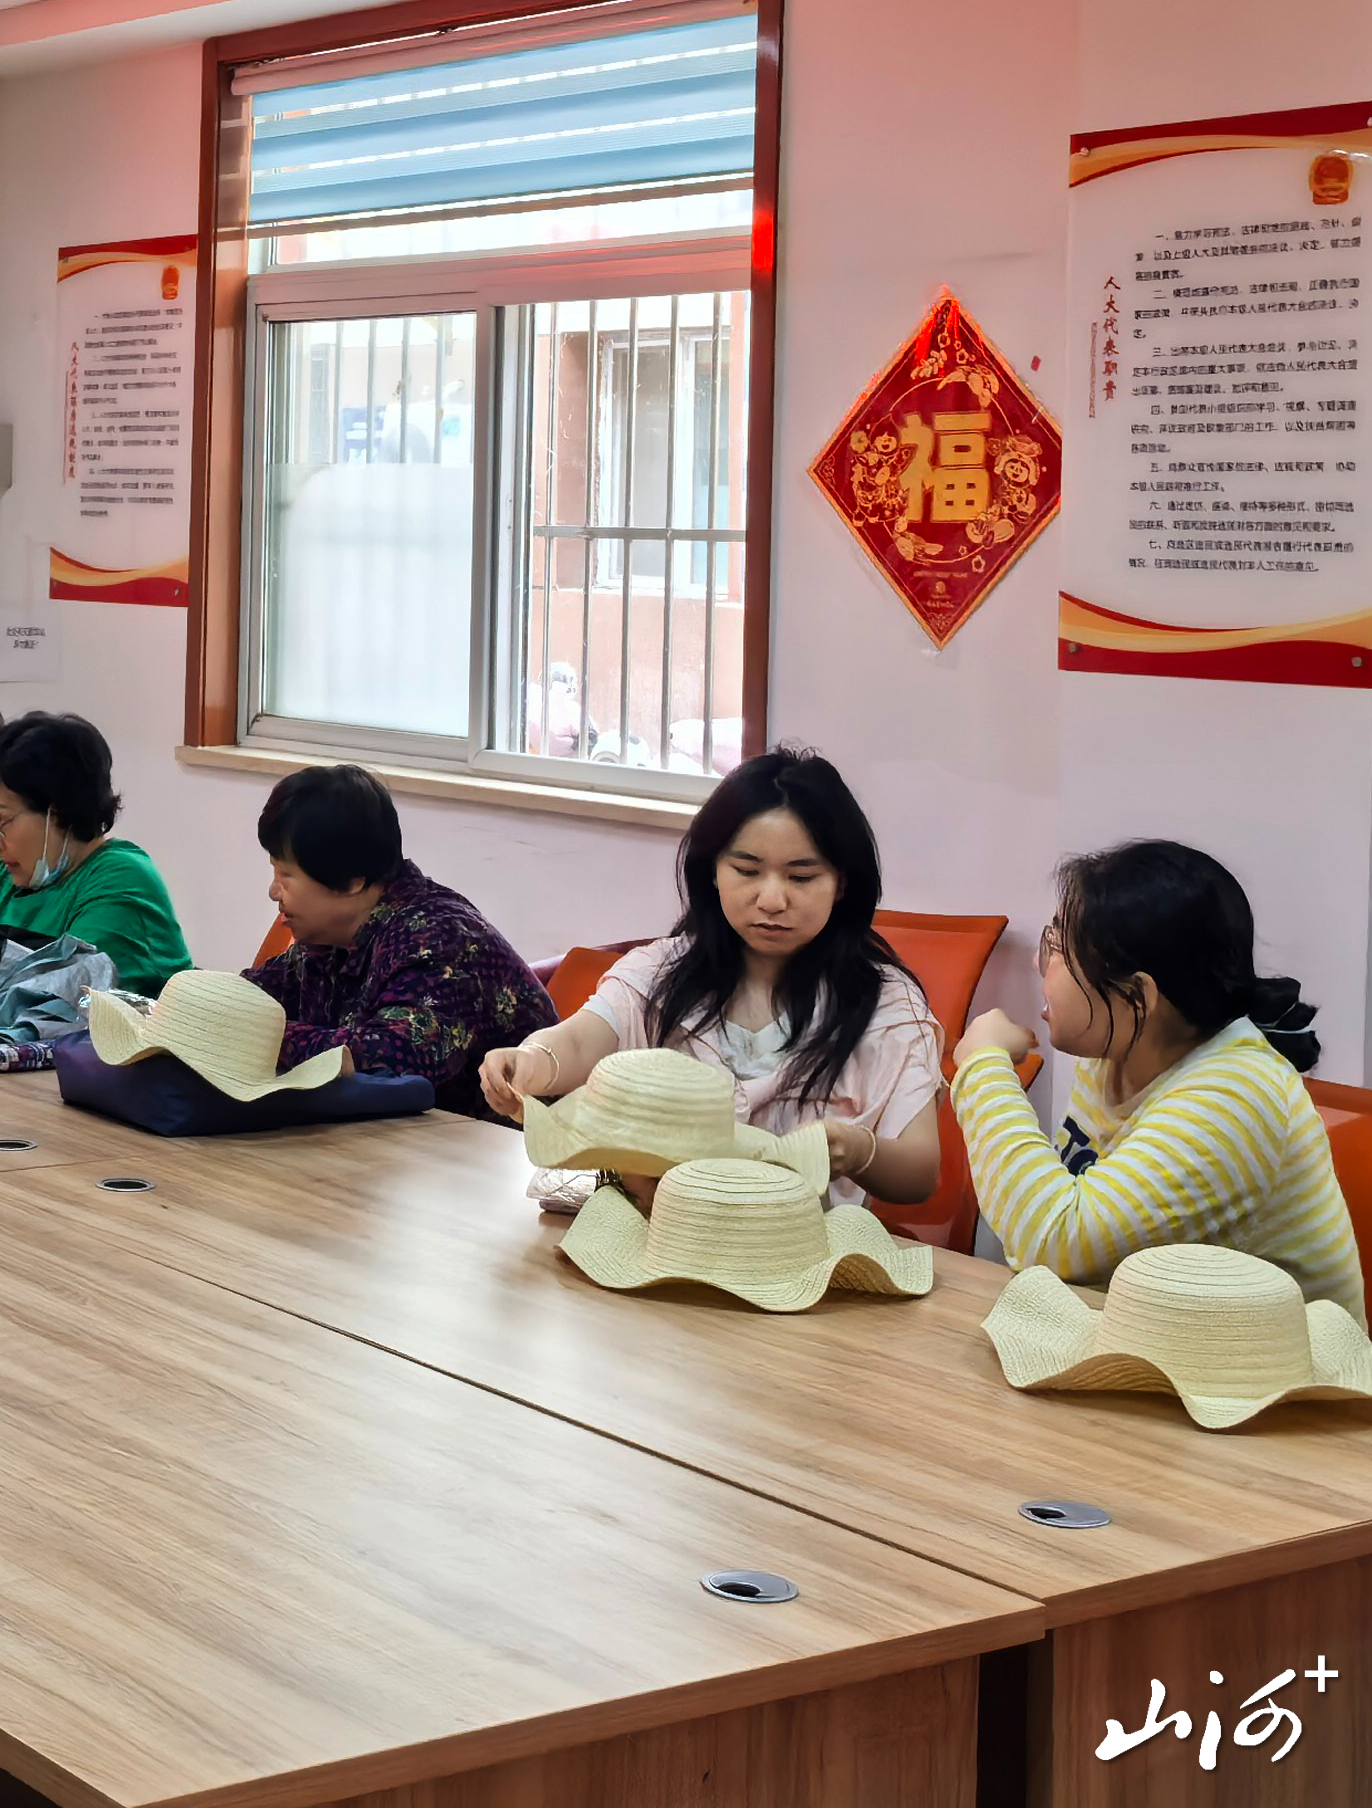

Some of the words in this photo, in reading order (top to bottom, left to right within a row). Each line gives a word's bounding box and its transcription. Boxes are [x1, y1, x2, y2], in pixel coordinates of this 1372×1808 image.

[1102, 276, 1121, 401] 人大代表职责
[899, 411, 992, 523] 福
